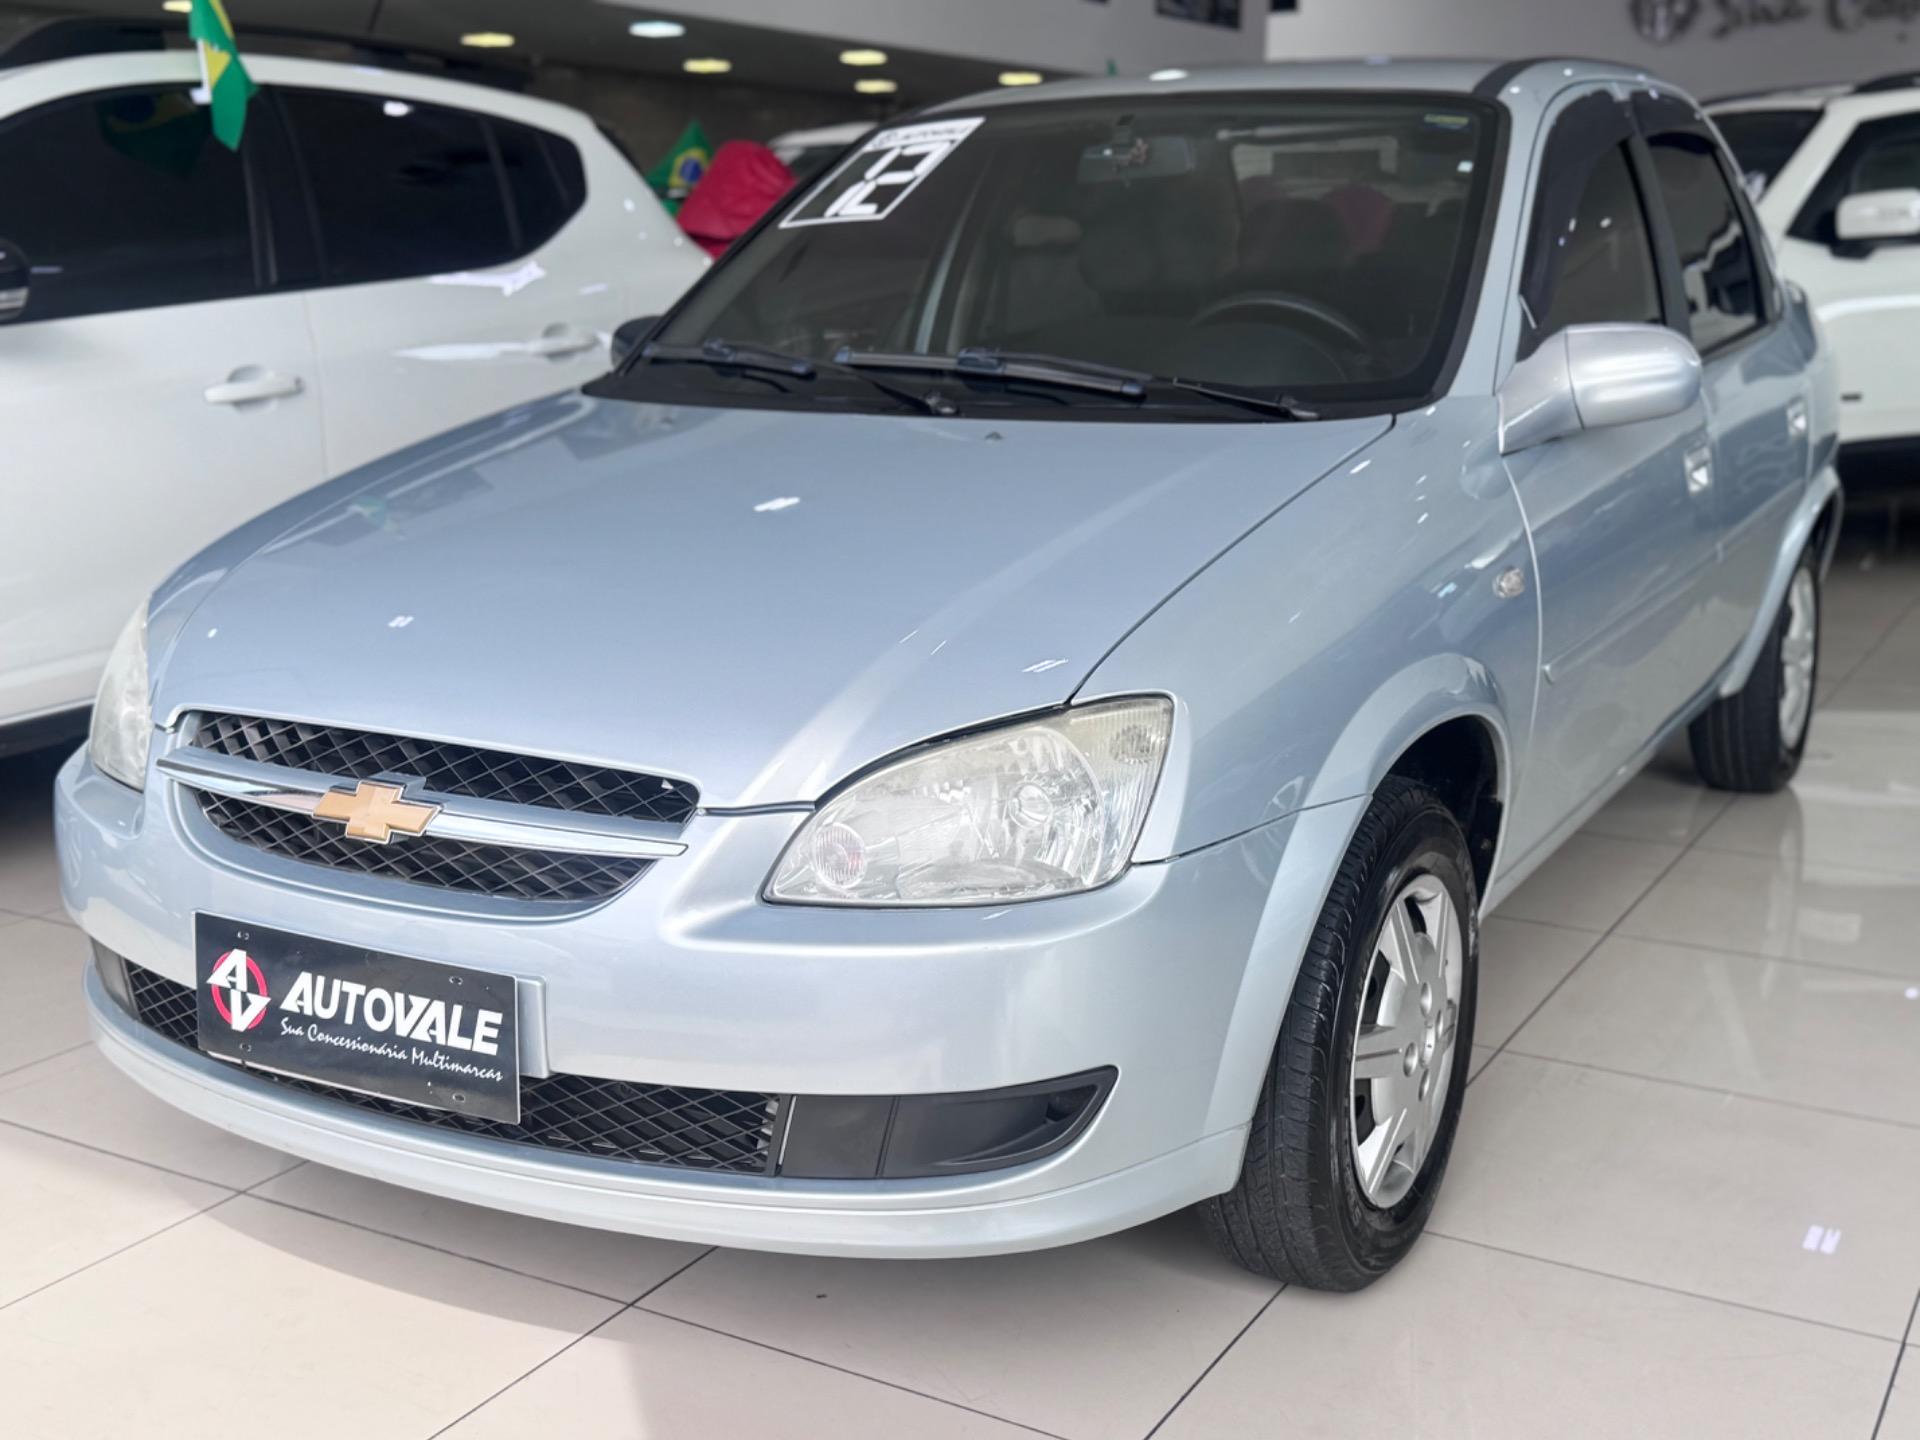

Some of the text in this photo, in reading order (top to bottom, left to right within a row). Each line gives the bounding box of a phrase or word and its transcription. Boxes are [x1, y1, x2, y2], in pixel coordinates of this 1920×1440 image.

[280, 971, 503, 1056] AUTOVALE
[281, 1017, 503, 1082] Sua Concessionária Multimarcas
